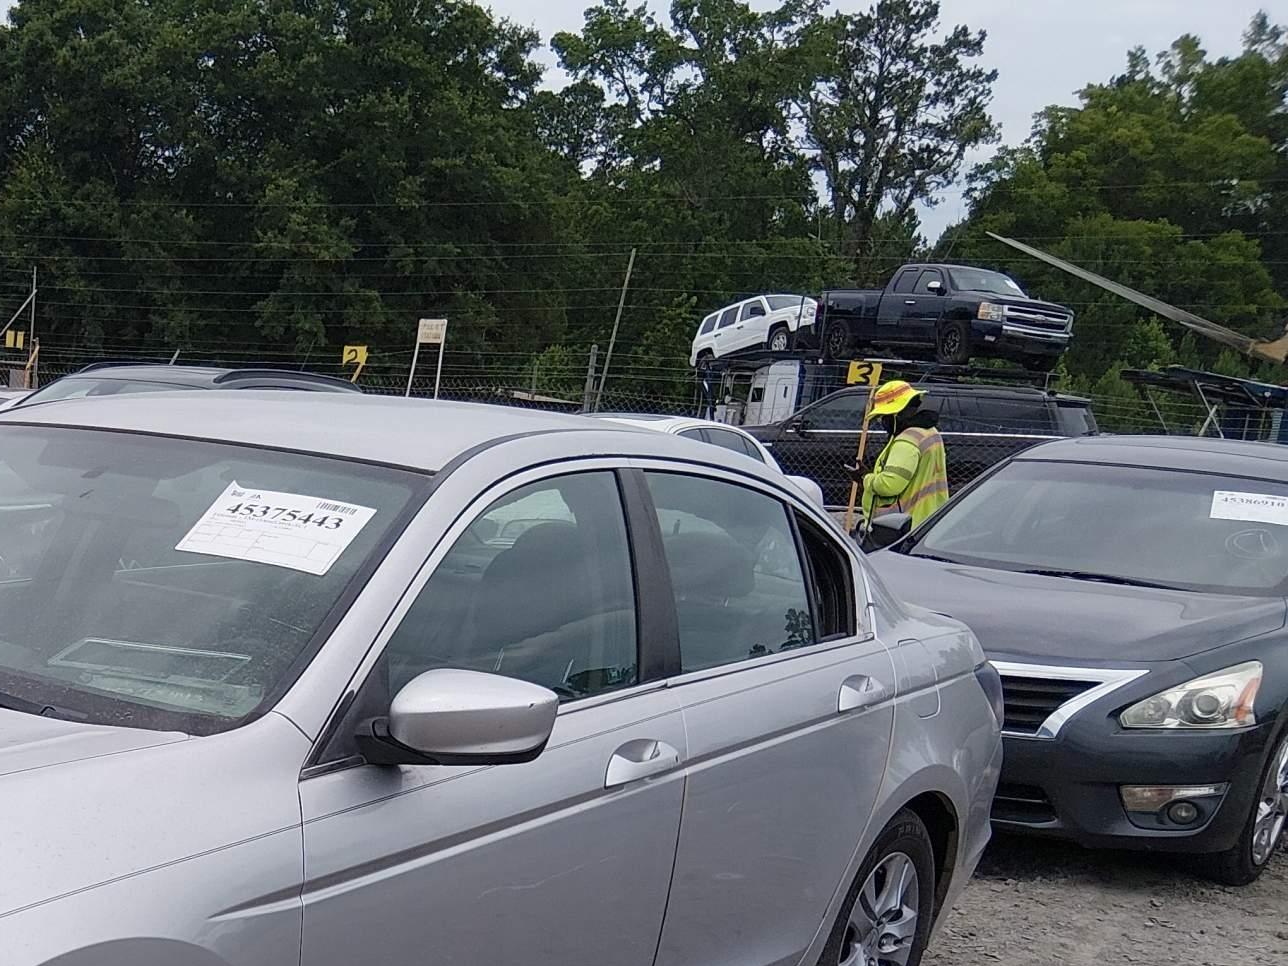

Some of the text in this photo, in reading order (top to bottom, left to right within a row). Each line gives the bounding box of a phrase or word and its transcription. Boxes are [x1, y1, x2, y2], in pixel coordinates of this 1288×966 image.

[344, 348, 361, 365] 2
[854, 362, 874, 385] 3
[226, 502, 344, 531] 45375443
